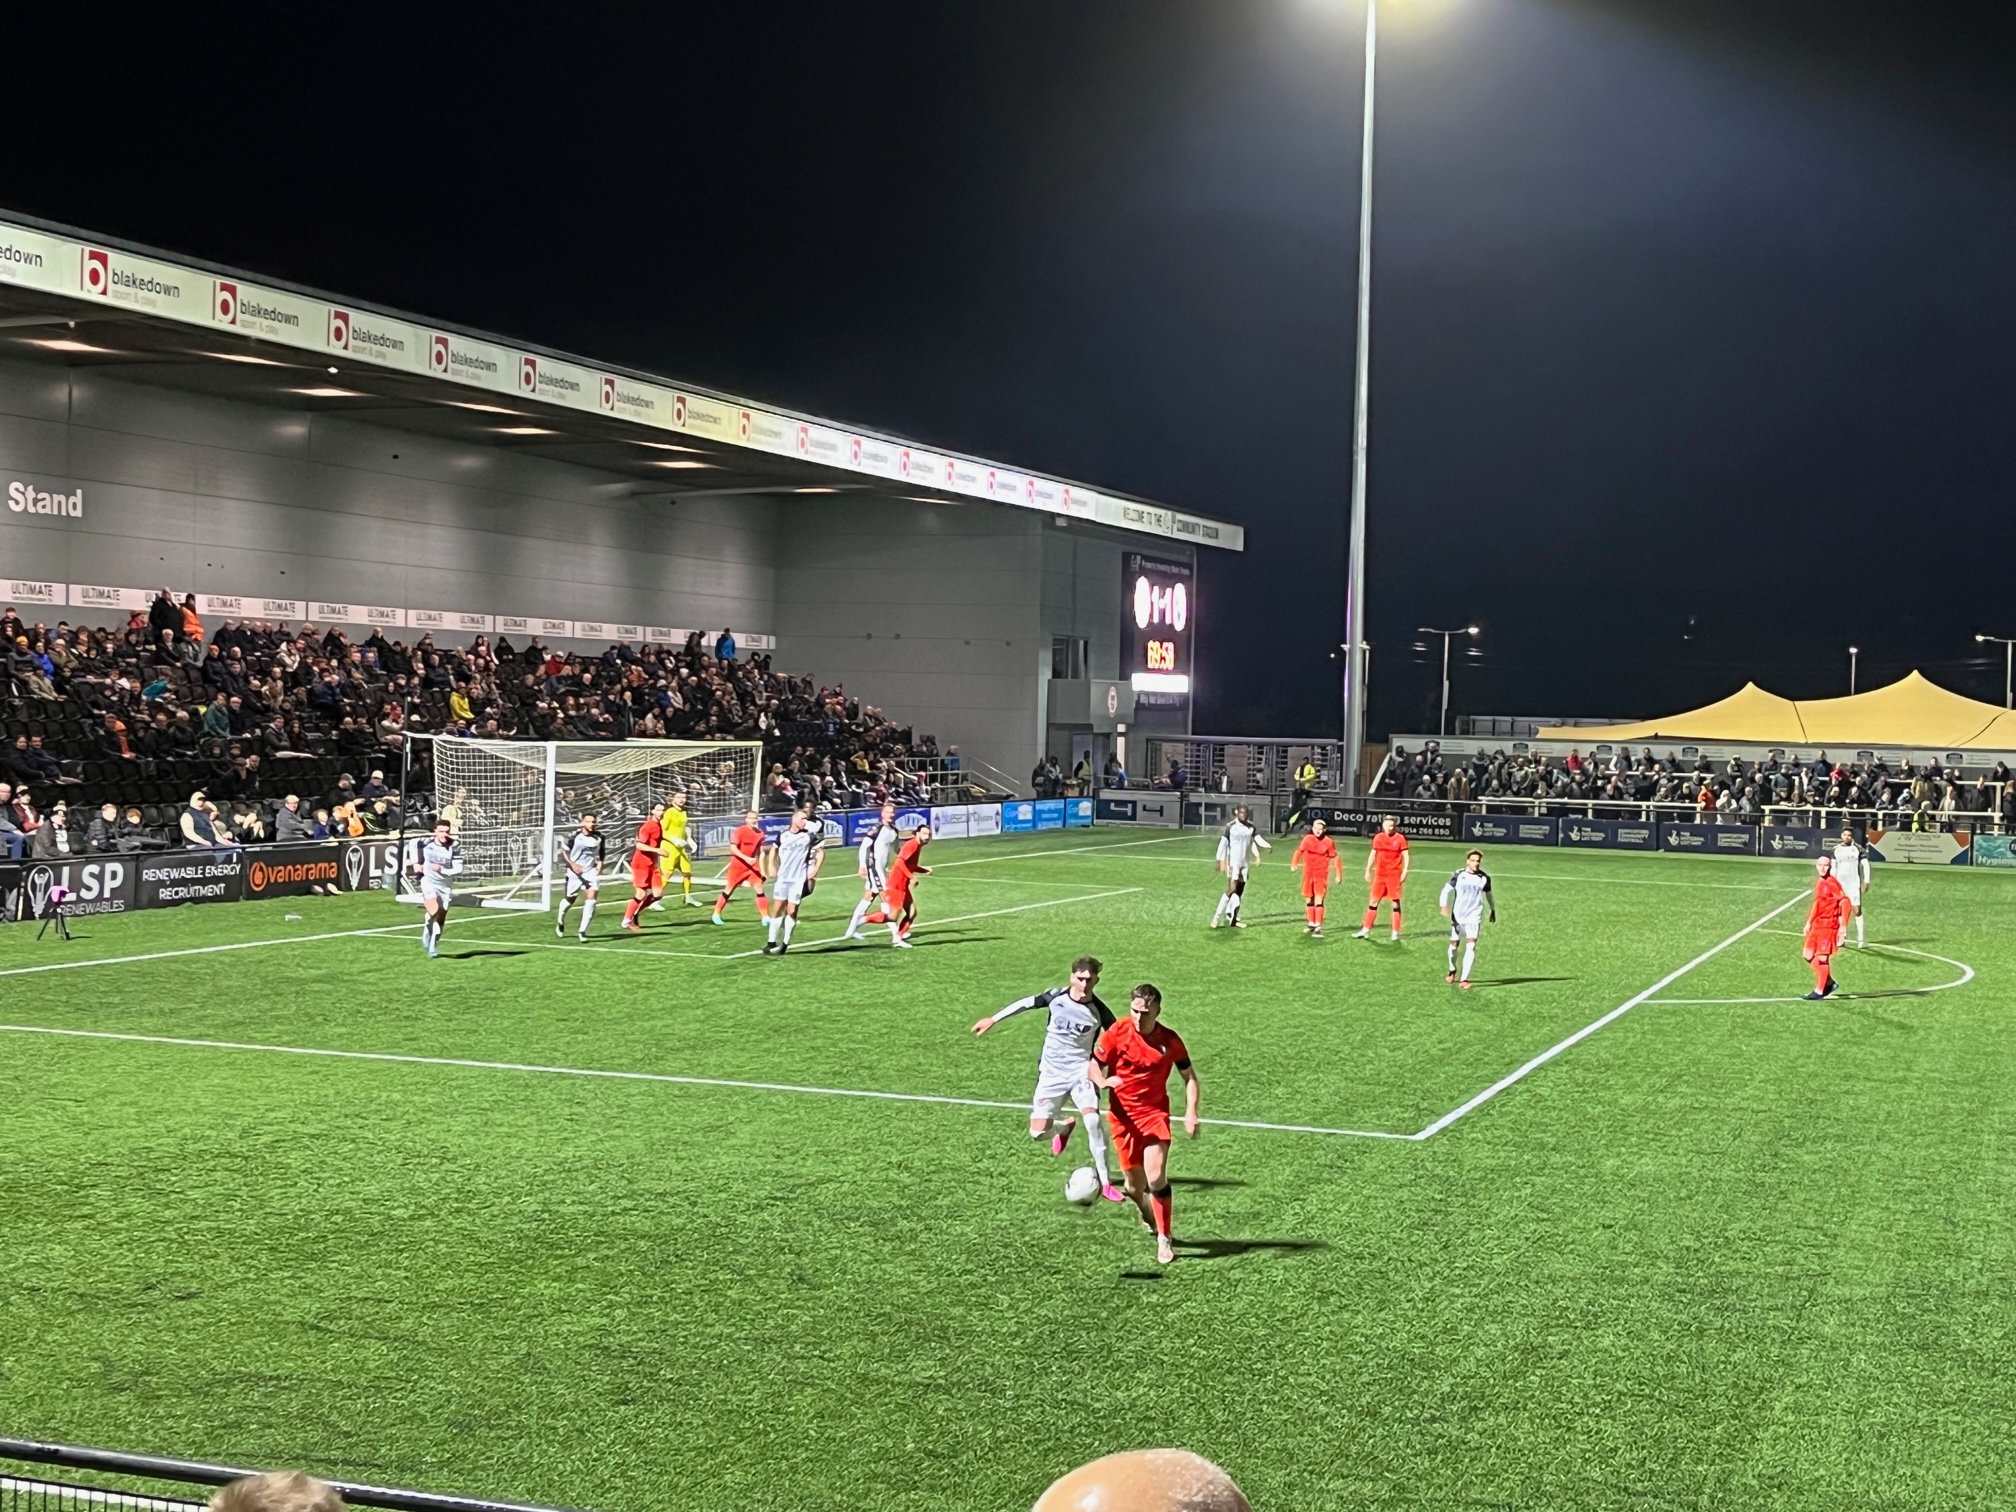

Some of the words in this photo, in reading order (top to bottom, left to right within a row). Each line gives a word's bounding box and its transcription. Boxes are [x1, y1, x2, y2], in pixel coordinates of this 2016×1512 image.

[112, 268, 180, 298] blakedown
[240, 299, 299, 327] blakedown
[352, 326, 404, 351] blakedown
[451, 350, 497, 373] blakedown
[538, 371, 580, 392] blakedown
[8, 481, 83, 518] Stand
[11, 583, 53, 596] ULTIMATE
[82, 587, 120, 601] ULTIMATE
[207, 597, 241, 609] ULTIMATE
[263, 601, 295, 613] ULTIMATE
[318, 605, 348, 616] ULTIMATE
[368, 608, 396, 619] ULTIMATE
[1403, 814, 1451, 826] services
[142, 866, 203, 881] RENEWABLE
[205, 863, 241, 877] ENERGY
[268, 861, 338, 883] vanarama
[61, 862, 124, 901] LSP
[159, 883, 226, 900] RECRUITMENT
[60, 900, 124, 916] RENEWABLES
